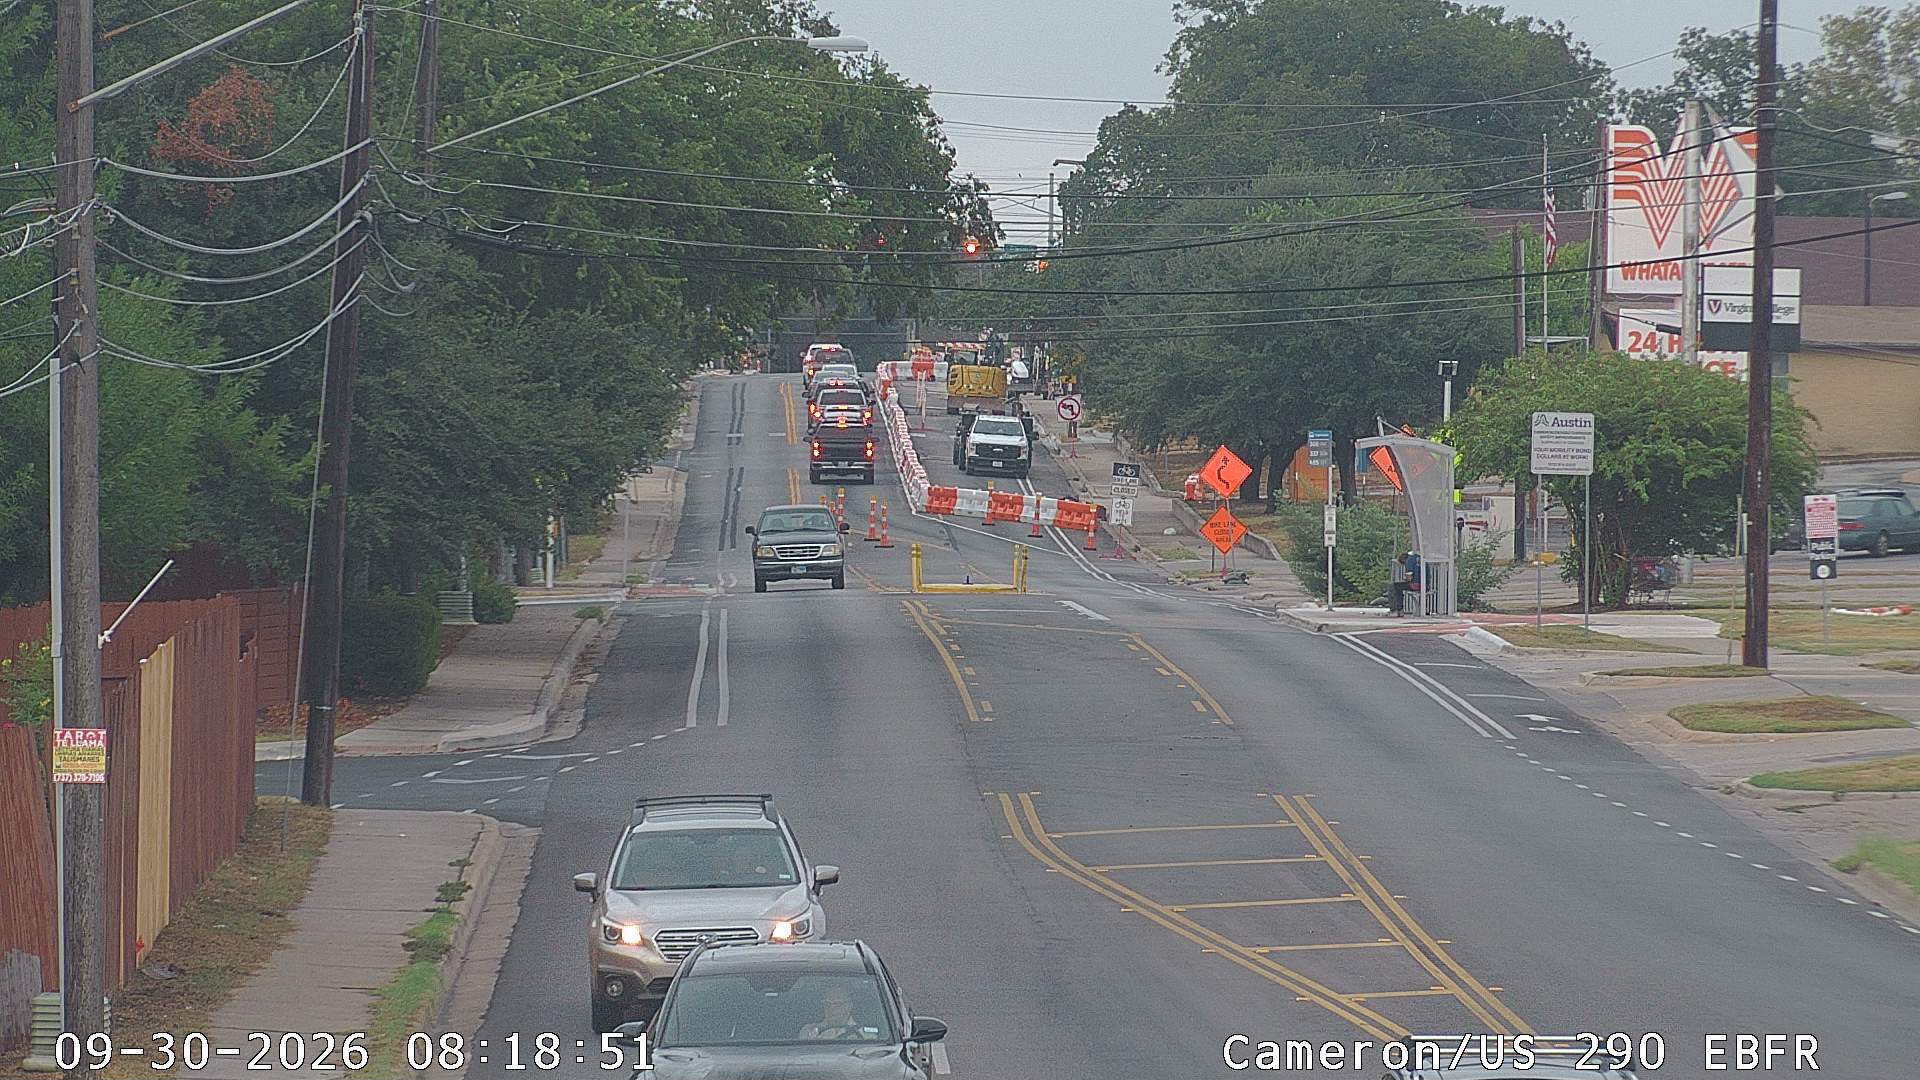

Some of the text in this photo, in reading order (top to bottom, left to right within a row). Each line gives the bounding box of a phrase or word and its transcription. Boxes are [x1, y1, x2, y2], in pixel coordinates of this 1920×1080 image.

[1628, 331, 1658, 353] 24
[1552, 417, 1592, 428] Austin
[54, 730, 106, 740] TAROT
